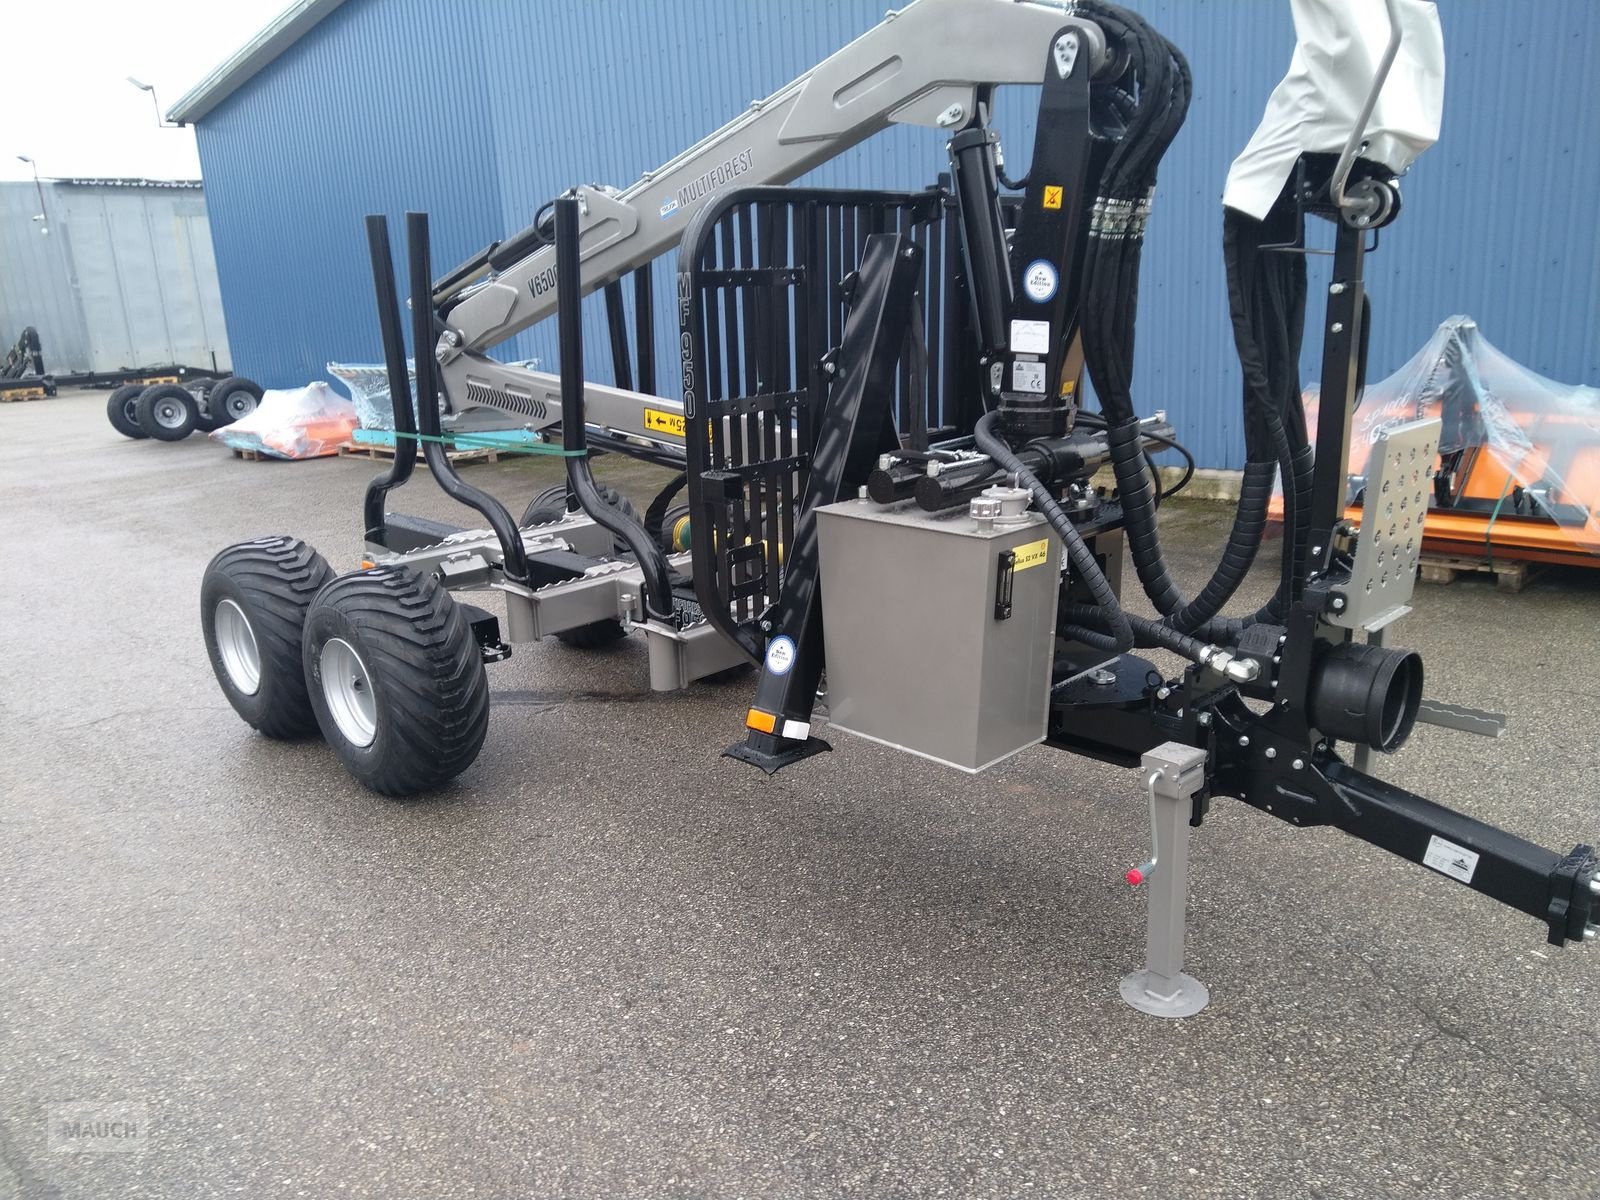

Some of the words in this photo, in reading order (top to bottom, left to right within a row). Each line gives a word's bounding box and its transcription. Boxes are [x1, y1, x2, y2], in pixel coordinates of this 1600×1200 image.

[678, 147, 753, 208] MULTIFOREST
[676, 271, 691, 327] MF
[680, 331, 696, 419] 950
